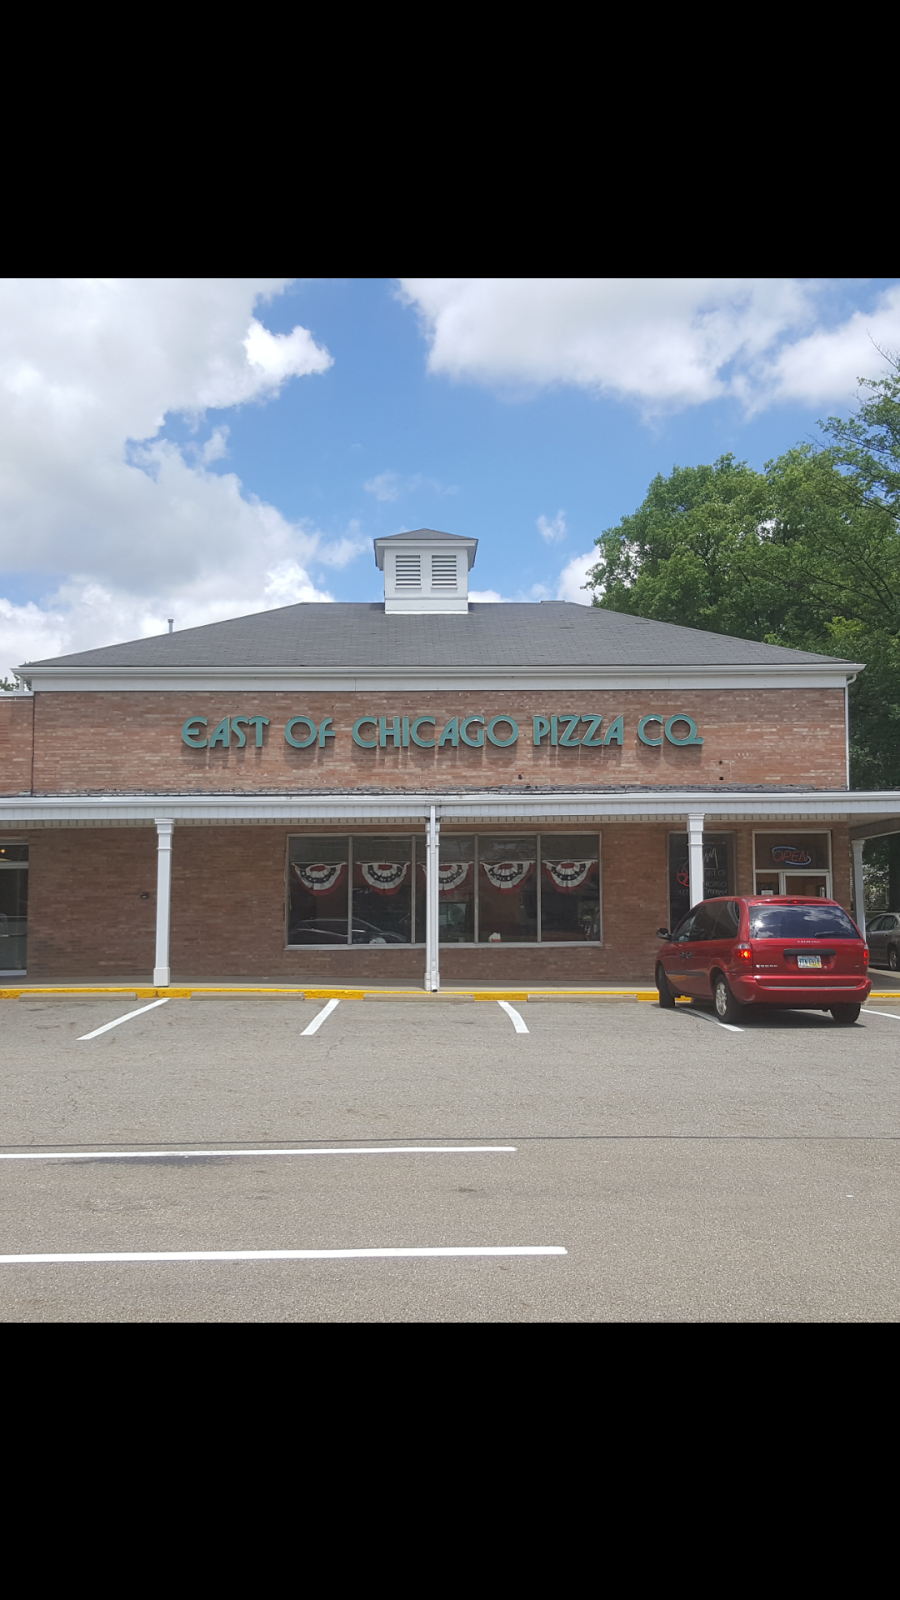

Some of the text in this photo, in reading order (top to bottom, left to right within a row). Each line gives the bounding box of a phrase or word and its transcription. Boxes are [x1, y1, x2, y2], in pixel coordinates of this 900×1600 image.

[181, 715, 270, 748] EAST
[284, 715, 336, 748] OF
[352, 715, 519, 748] CHICAGO
[533, 713, 624, 747] PIZZA
[773, 850, 809, 862] OPEN
